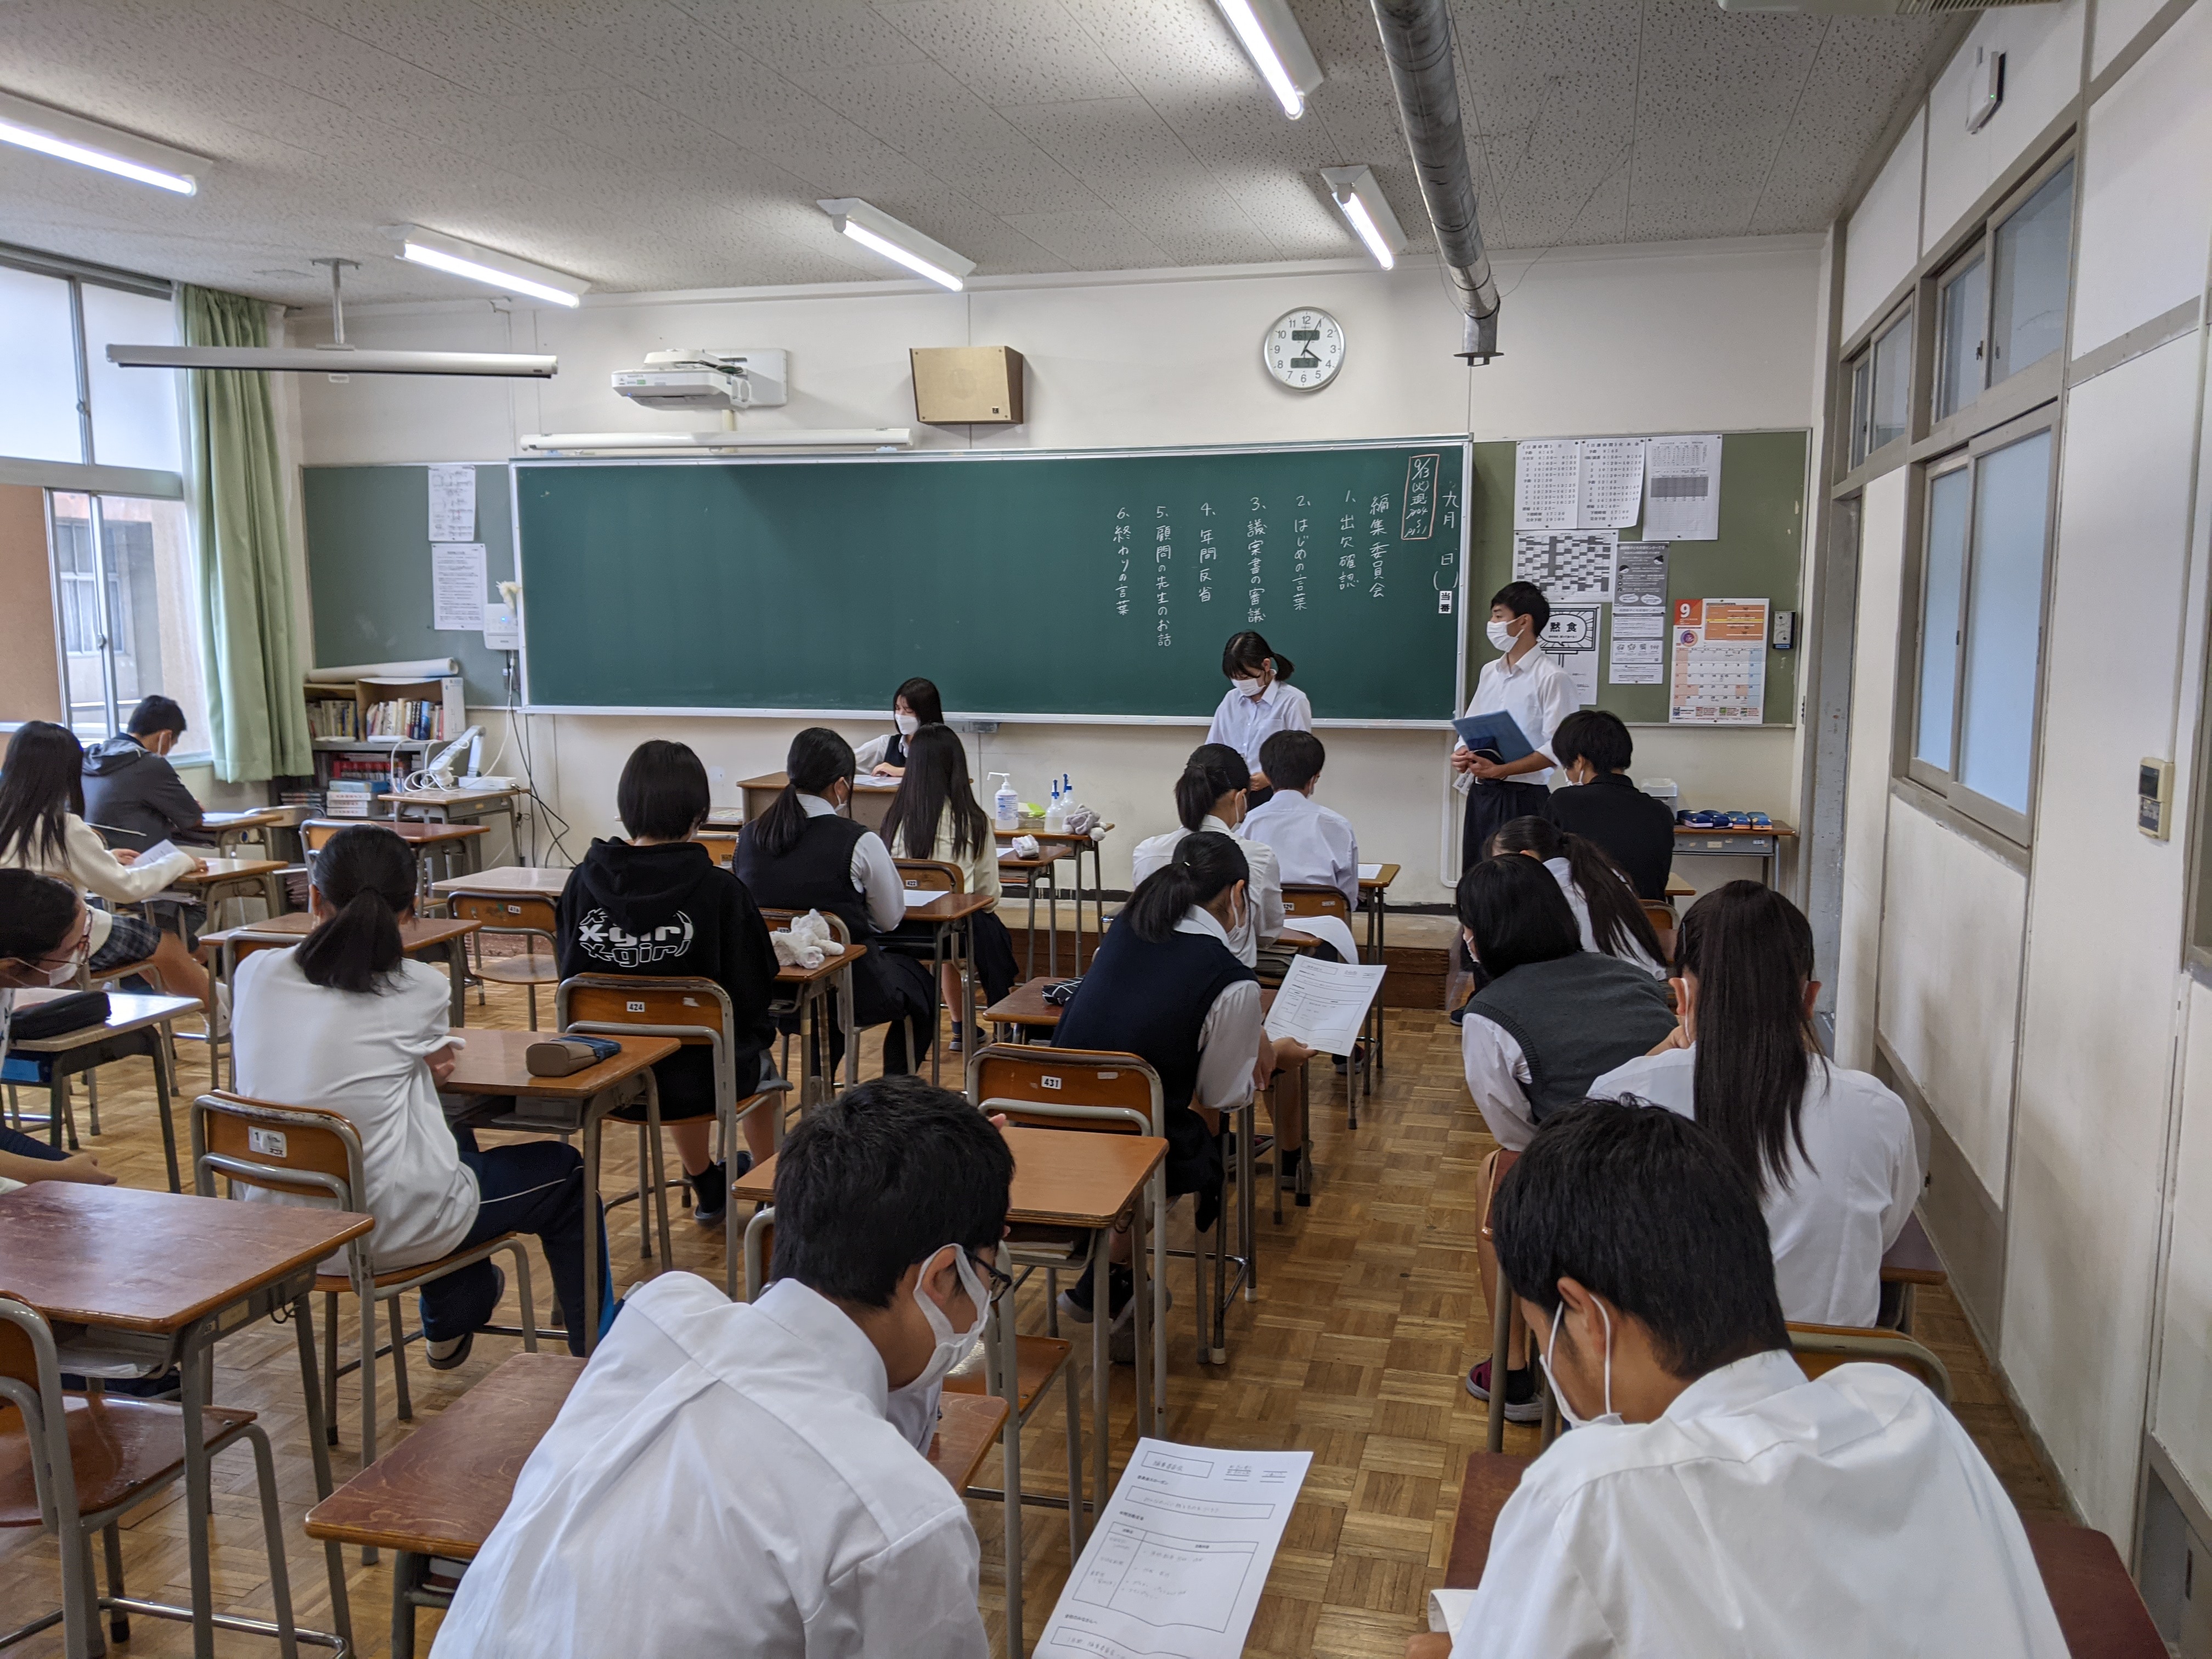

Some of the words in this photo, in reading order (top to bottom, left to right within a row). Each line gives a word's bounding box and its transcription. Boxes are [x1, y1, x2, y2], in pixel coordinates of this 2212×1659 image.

[1302, 316, 1311, 324] 12
[1278, 330, 1286, 338] 10
[1330, 345, 1336, 353] 3
[1325, 360, 1331, 368] 4
[1315, 370, 1321, 379] 5
[1369, 494, 1390, 597] 編集委員会
[1440, 592, 1451, 613] 当番
[1680, 603, 1690, 618] 9
[1550, 622, 1577, 633] 黙食
[1044, 1078, 1059, 1088] 431
